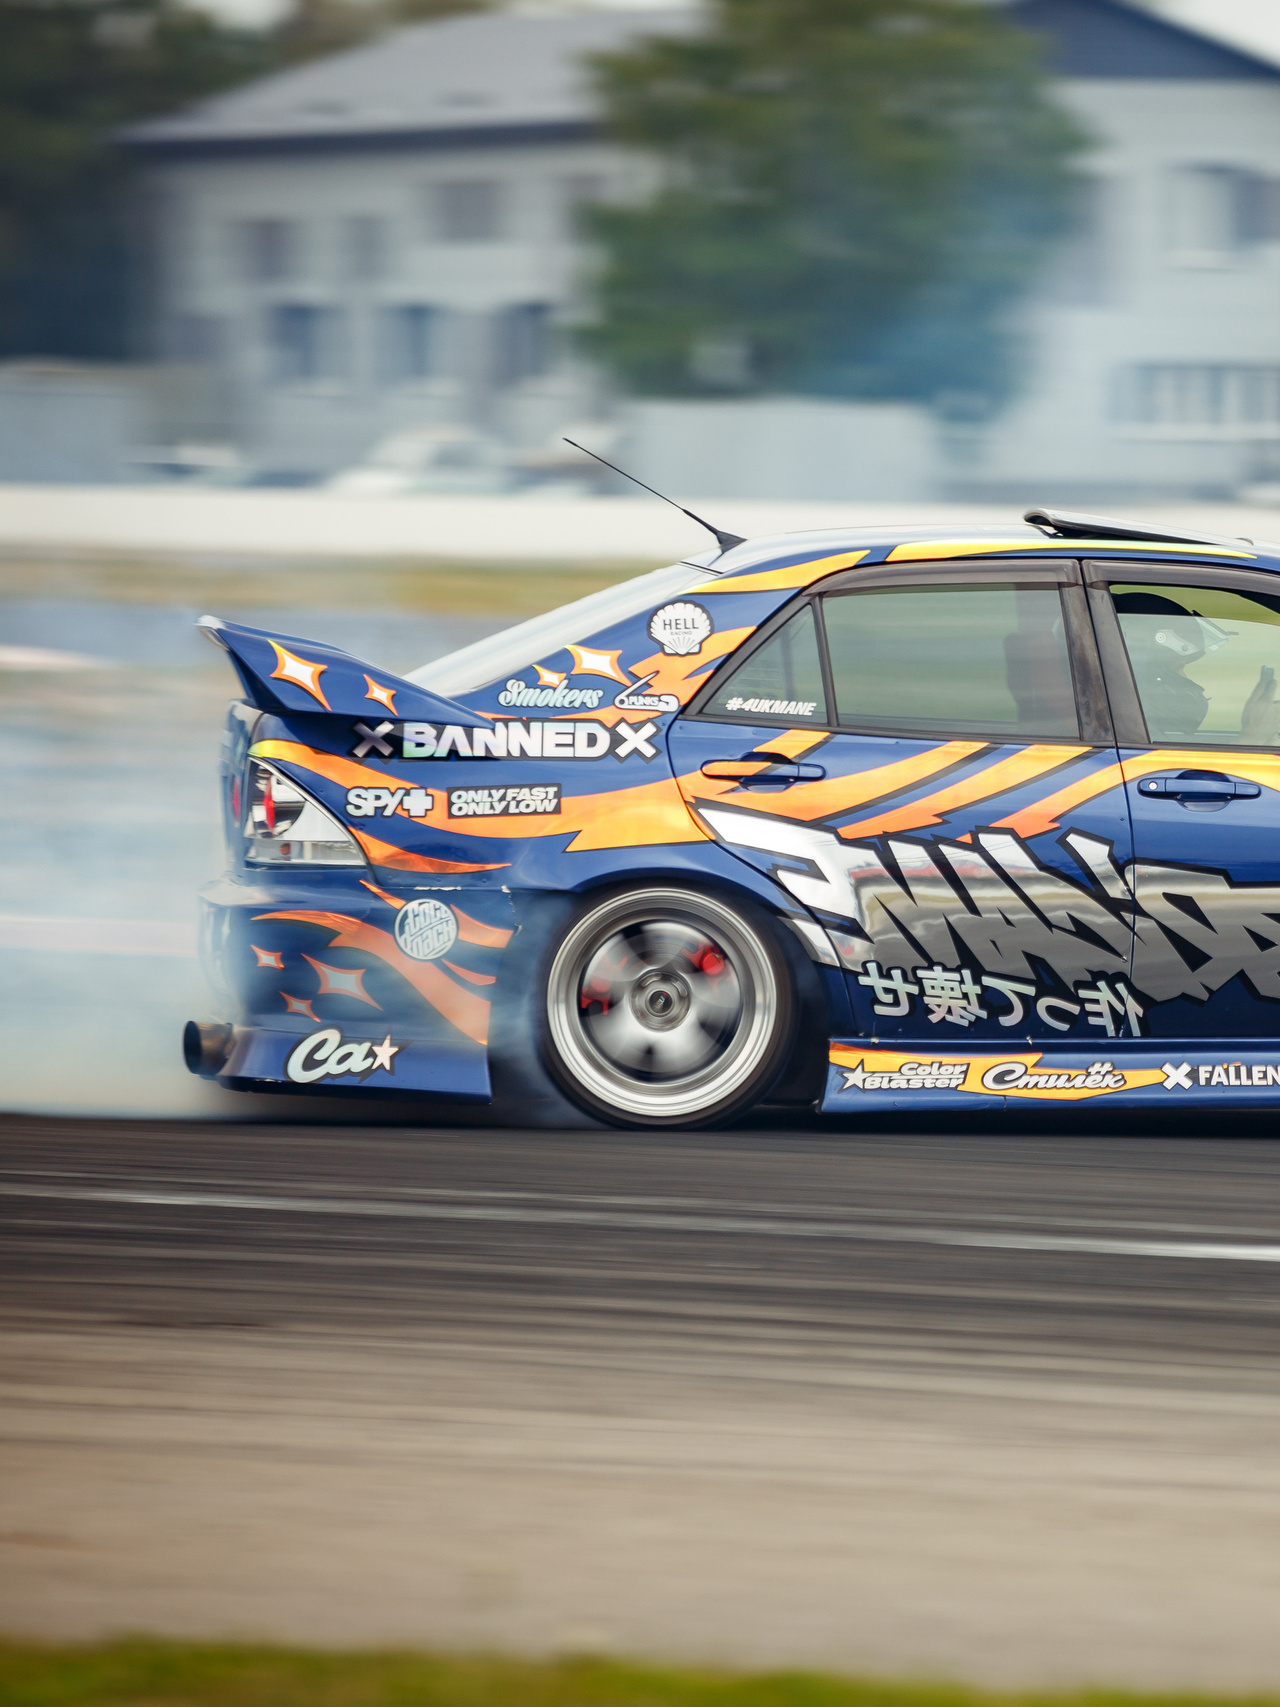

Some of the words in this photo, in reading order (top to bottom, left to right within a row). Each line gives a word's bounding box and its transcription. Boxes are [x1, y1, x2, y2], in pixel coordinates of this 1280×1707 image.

[662, 617, 700, 631] HELL
[499, 678, 604, 709] Smokers
[725, 696, 818, 716] #4UKMANE
[402, 721, 611, 758] BANNED
[450, 789, 506, 804] ONLY
[505, 786, 559, 801] FAST
[450, 800, 509, 816] ONLY
[508, 798, 559, 814] LOW
[899, 1061, 970, 1076] Color
[863, 1075, 966, 1090] Blaster
